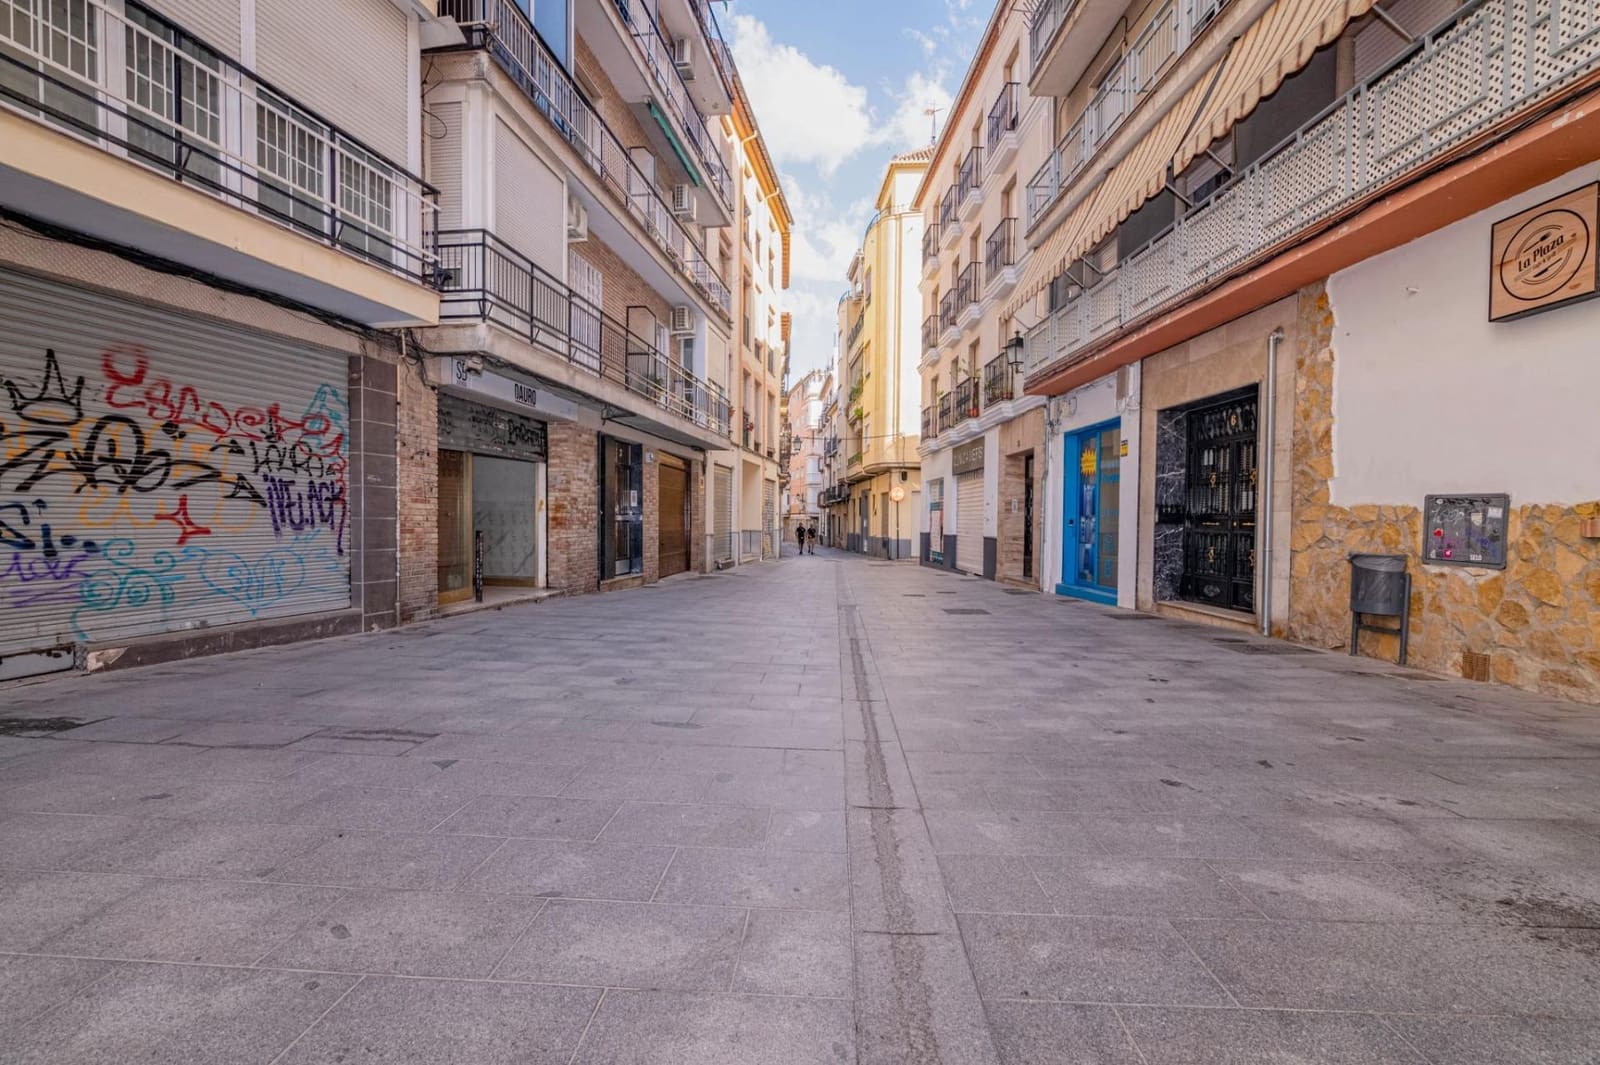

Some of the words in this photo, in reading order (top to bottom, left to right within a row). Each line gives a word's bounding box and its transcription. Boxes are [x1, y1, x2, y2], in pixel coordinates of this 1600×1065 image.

[1518, 258, 1530, 272] La
[1533, 234, 1564, 262] Plaza
[514, 383, 537, 406] DAURO
